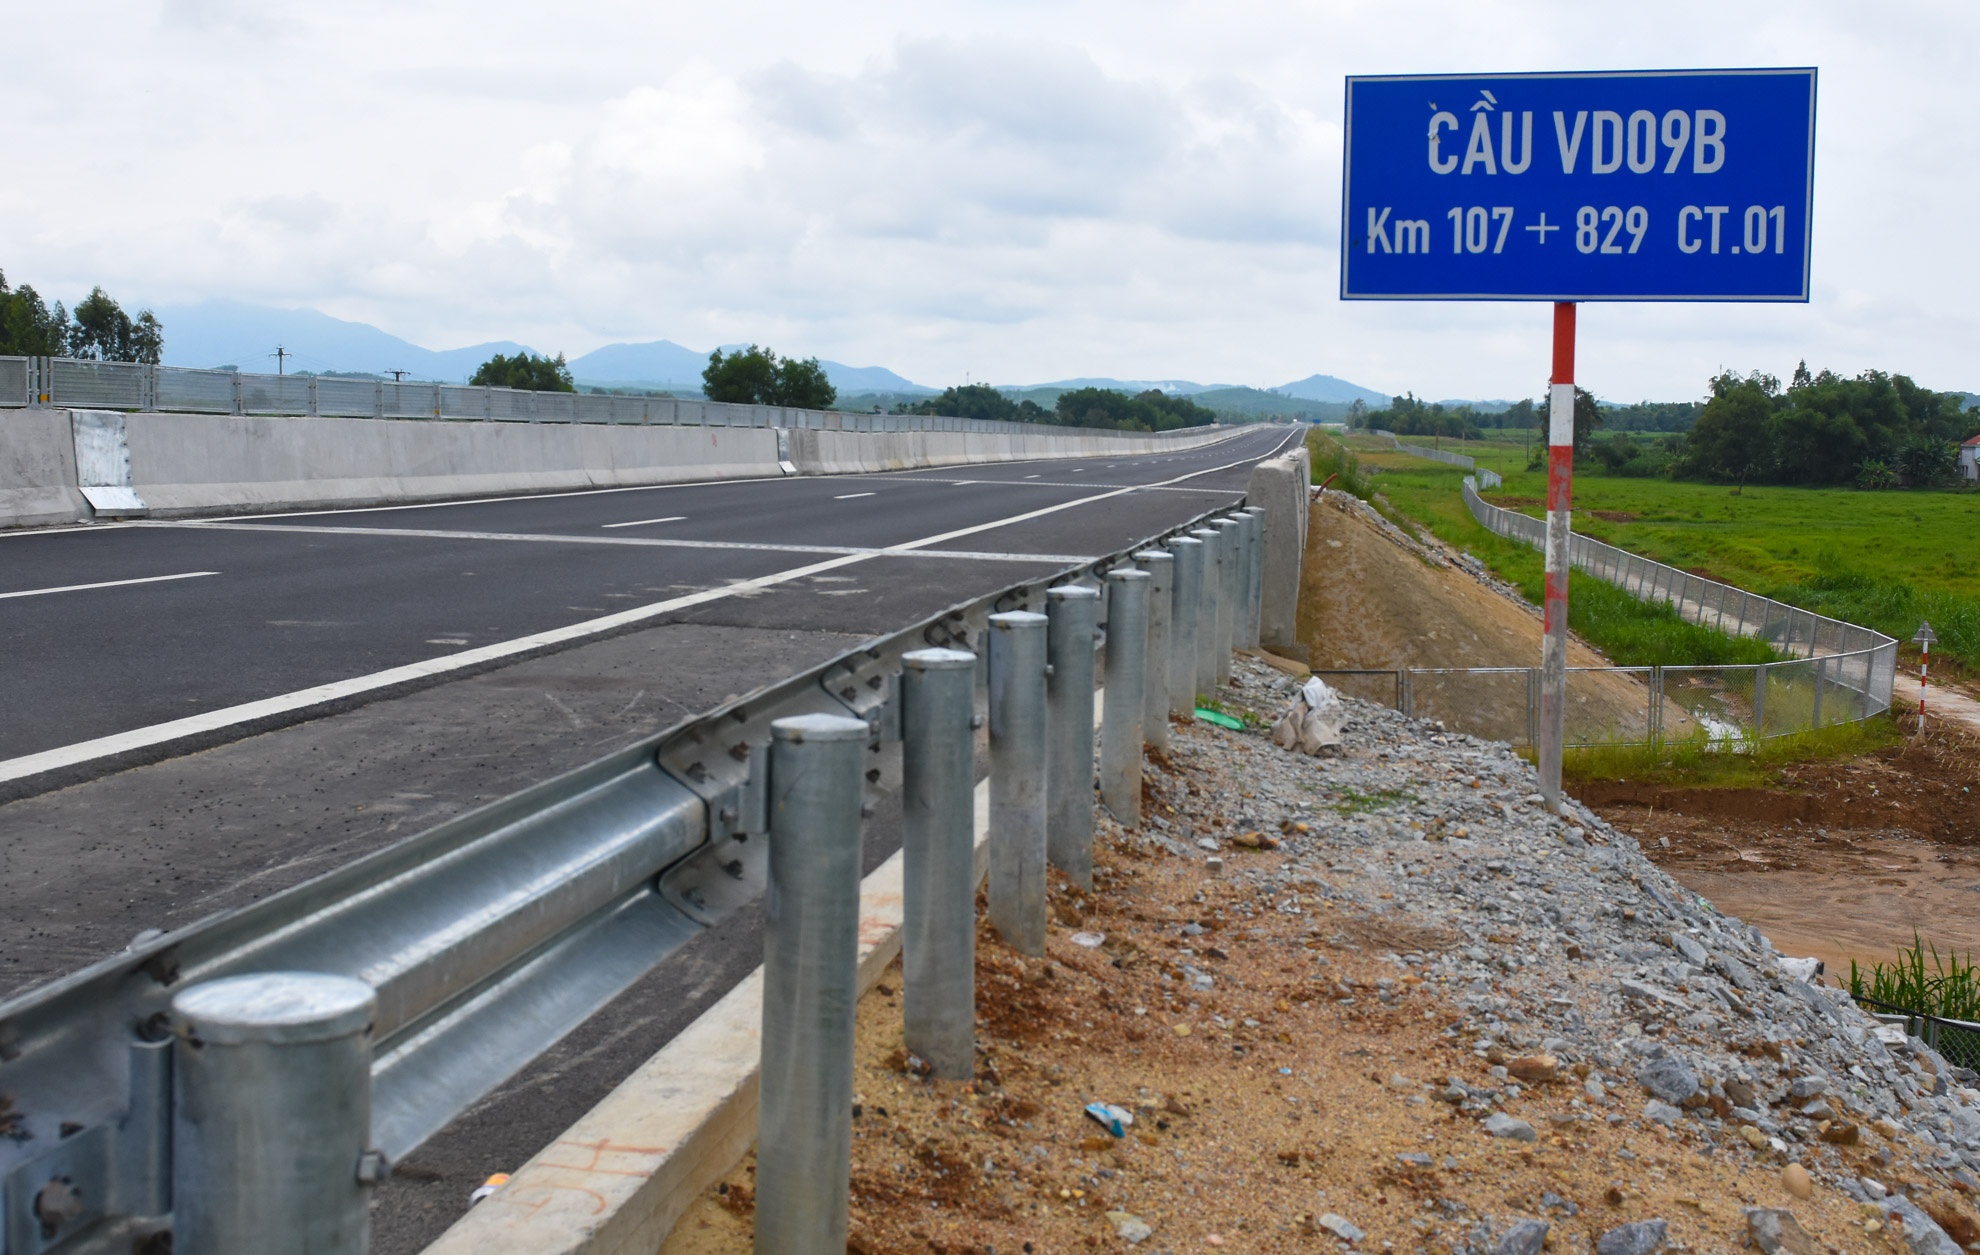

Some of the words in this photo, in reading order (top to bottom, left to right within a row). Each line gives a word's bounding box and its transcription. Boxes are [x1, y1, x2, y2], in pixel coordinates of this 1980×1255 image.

[1427, 90, 1533, 175] CẦU
[1553, 109, 1727, 174] VD09B
[1367, 206, 1430, 254] Km
[1447, 206, 1514, 254] 107
[1525, 212, 1560, 244] +
[1576, 205, 1649, 254] 829
[1677, 205, 1785, 254] CT.01
